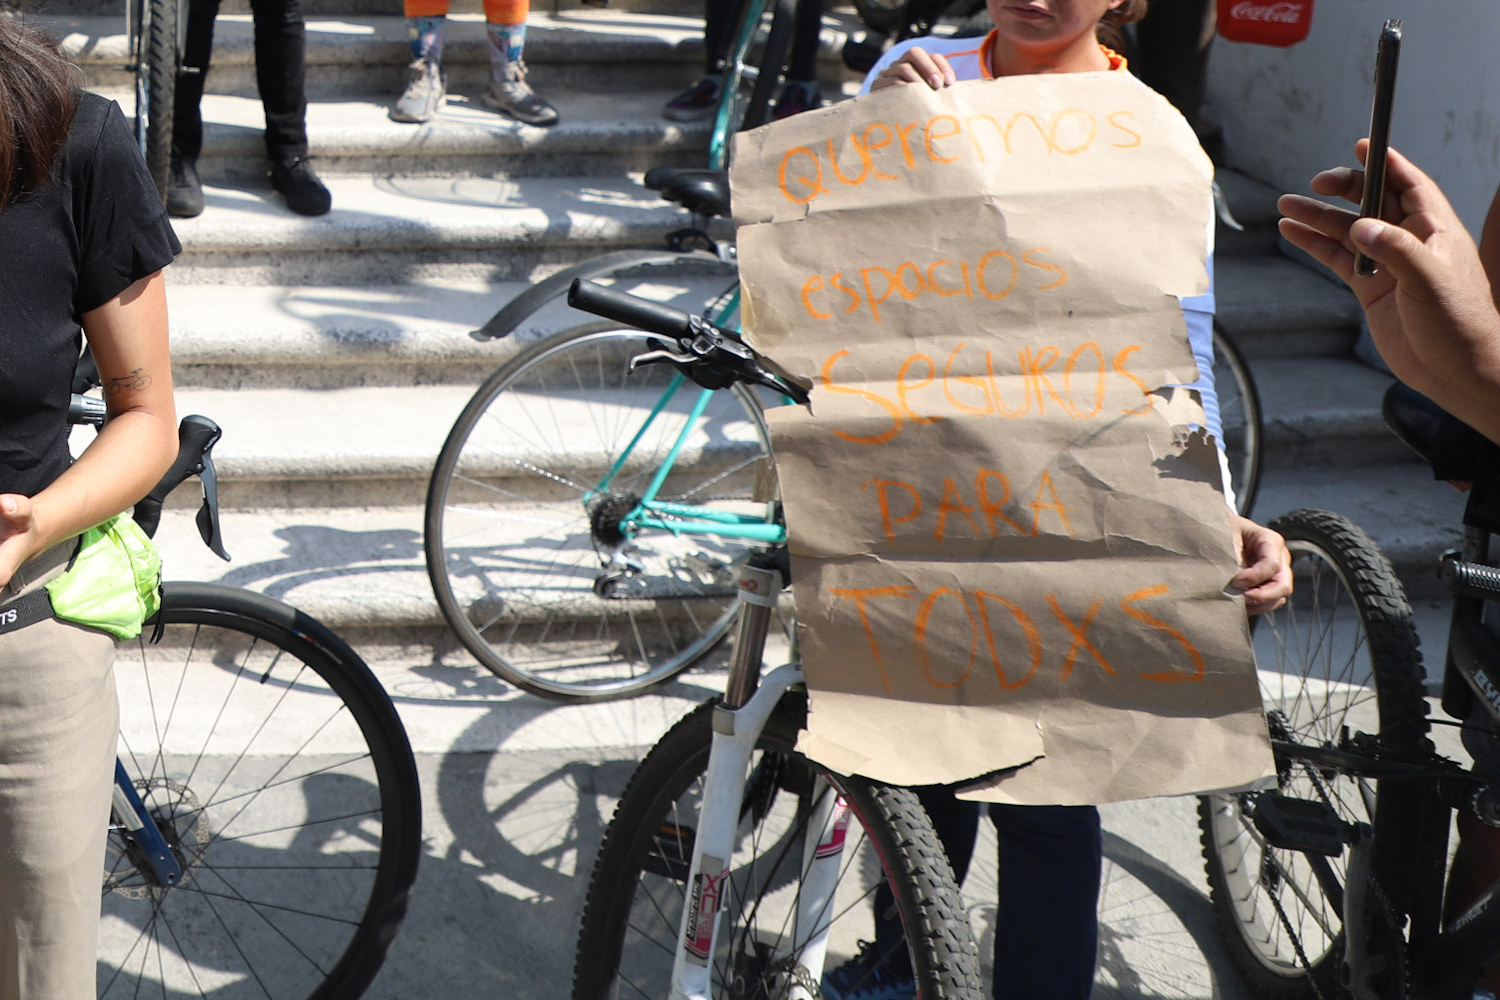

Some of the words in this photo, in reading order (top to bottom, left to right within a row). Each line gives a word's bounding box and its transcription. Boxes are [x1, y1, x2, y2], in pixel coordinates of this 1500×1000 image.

[799, 246, 1071, 322] espacios
[859, 466, 1077, 542] PARA
[828, 581, 1206, 697] TODXS
